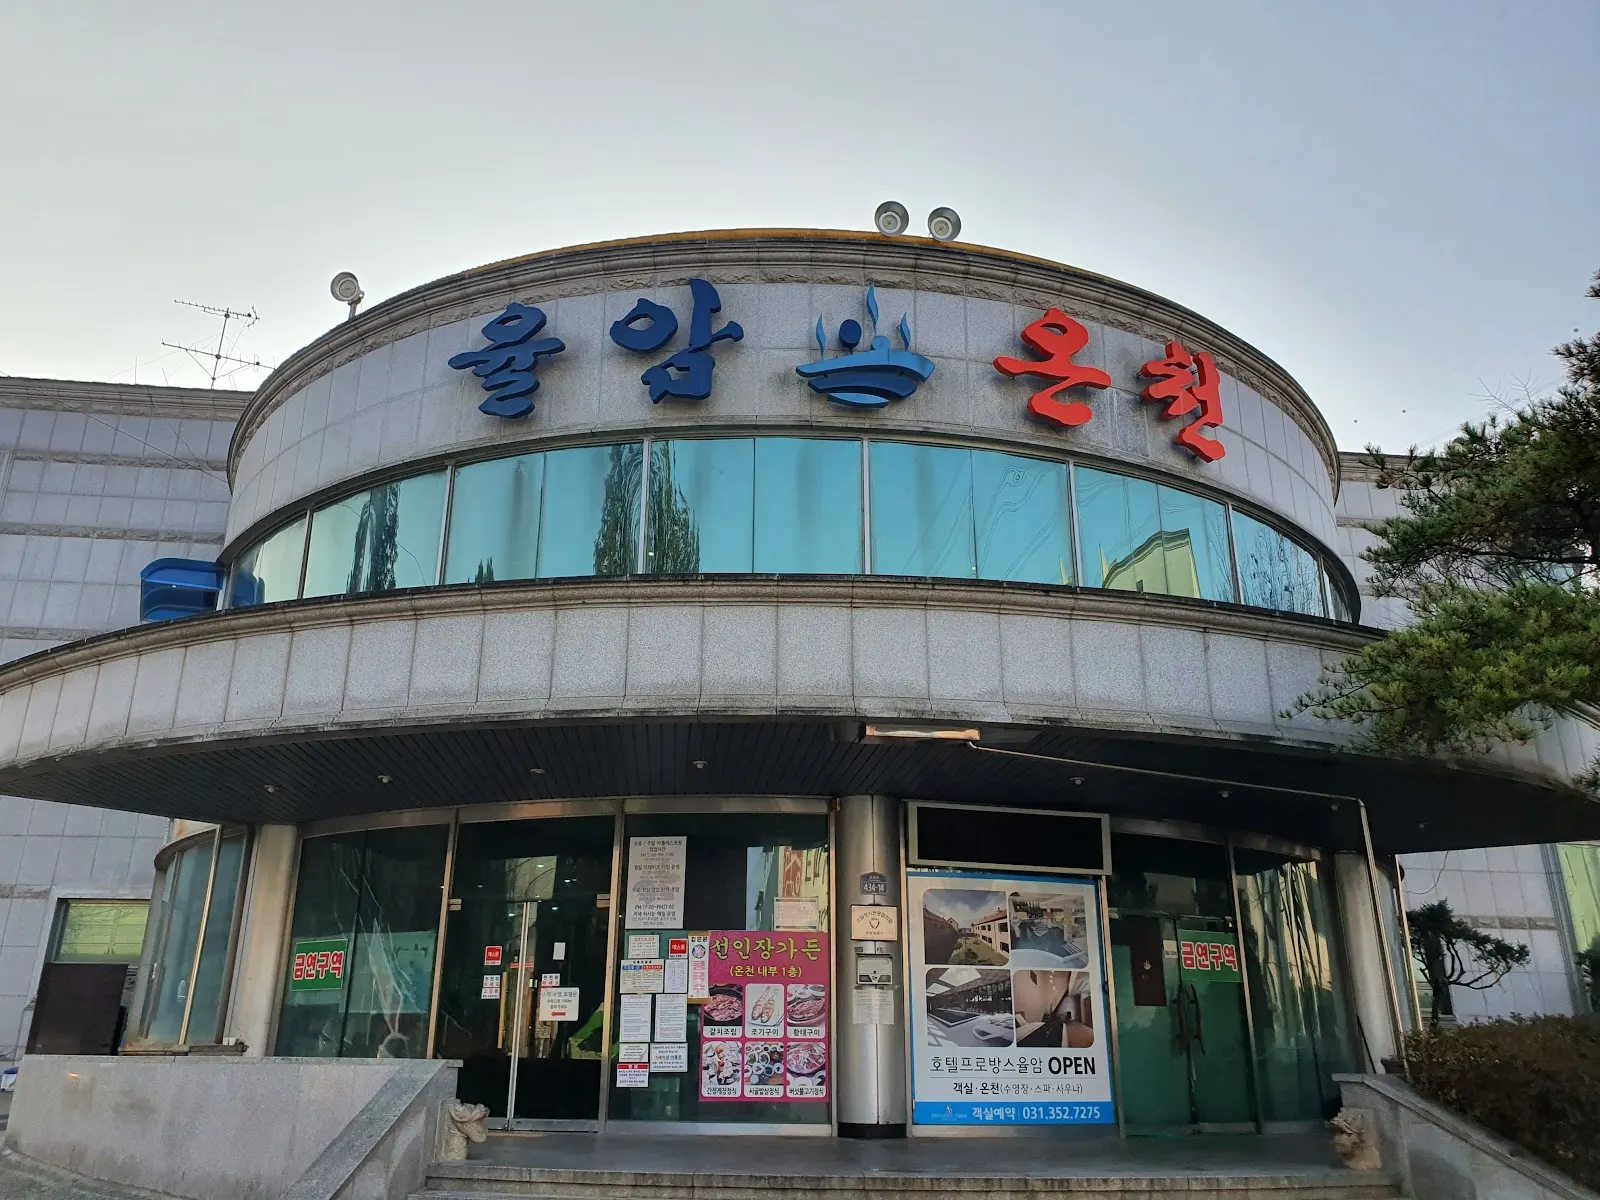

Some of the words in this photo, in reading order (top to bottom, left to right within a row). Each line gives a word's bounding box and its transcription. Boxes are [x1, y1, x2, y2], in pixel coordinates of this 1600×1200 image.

[992, 306, 1226, 463] 온천
[863, 882, 885, 892] 434-14
[710, 936, 822, 960] 선인장가든
[1180, 941, 1239, 972] 금연구역
[293, 951, 345, 980] 금연구역
[729, 965, 755, 978] (온천
[757, 965, 778, 977] 내부
[781, 965, 802, 978] 1층)
[751, 1028, 779, 1036] 조기구이
[929, 1056, 1043, 1074] 호텔프로방스율암
[1048, 1056, 1096, 1075] OPEN
[971, 1106, 1016, 1120] 객실예약
[1022, 1106, 1101, 1120] 031.352.7275
